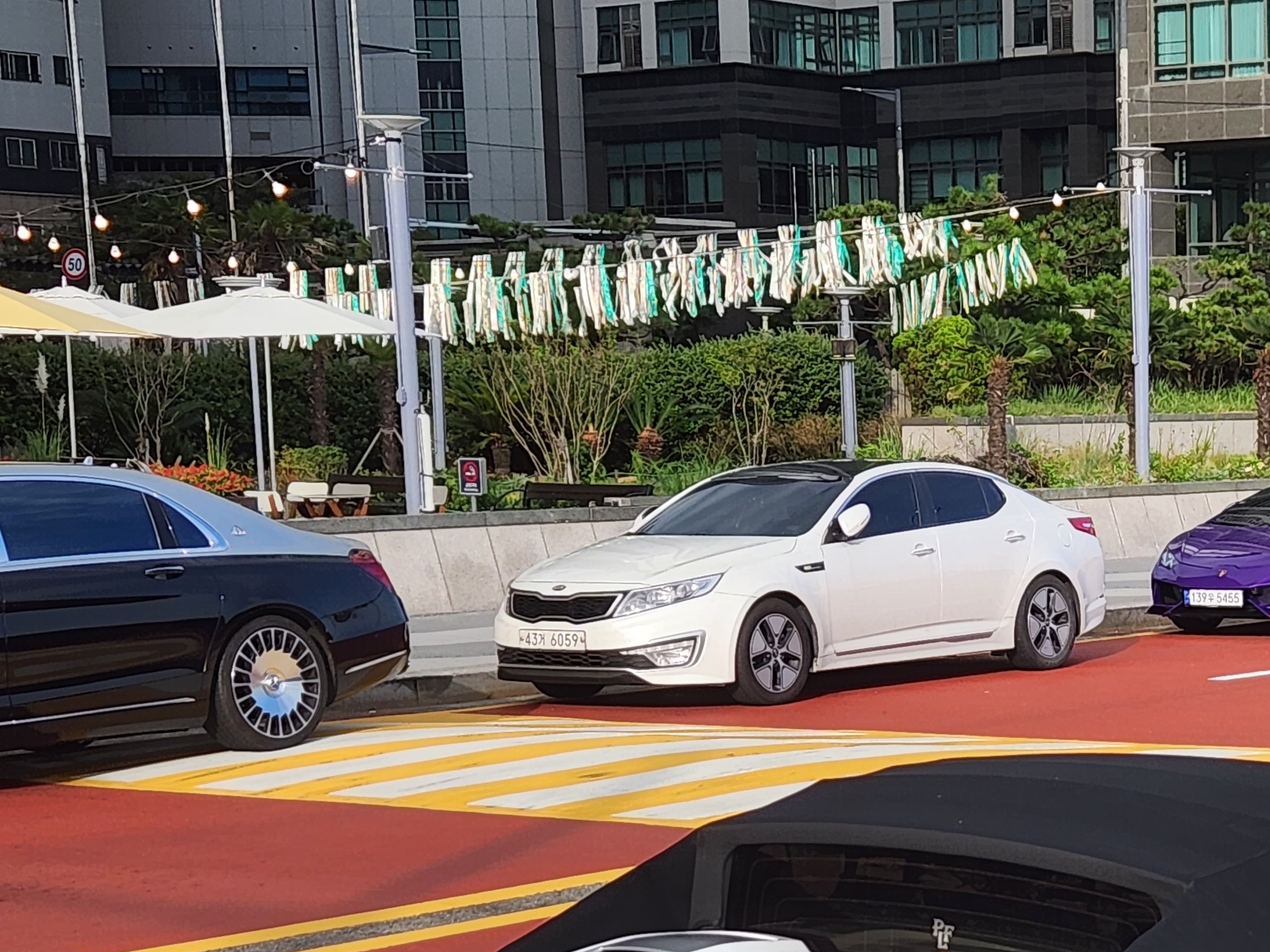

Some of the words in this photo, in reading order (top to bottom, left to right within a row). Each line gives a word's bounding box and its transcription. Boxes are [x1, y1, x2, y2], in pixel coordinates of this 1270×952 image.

[68, 257, 82, 271] 50
[1216, 592, 1240, 604] 5455
[550, 633, 579, 647] 6059
